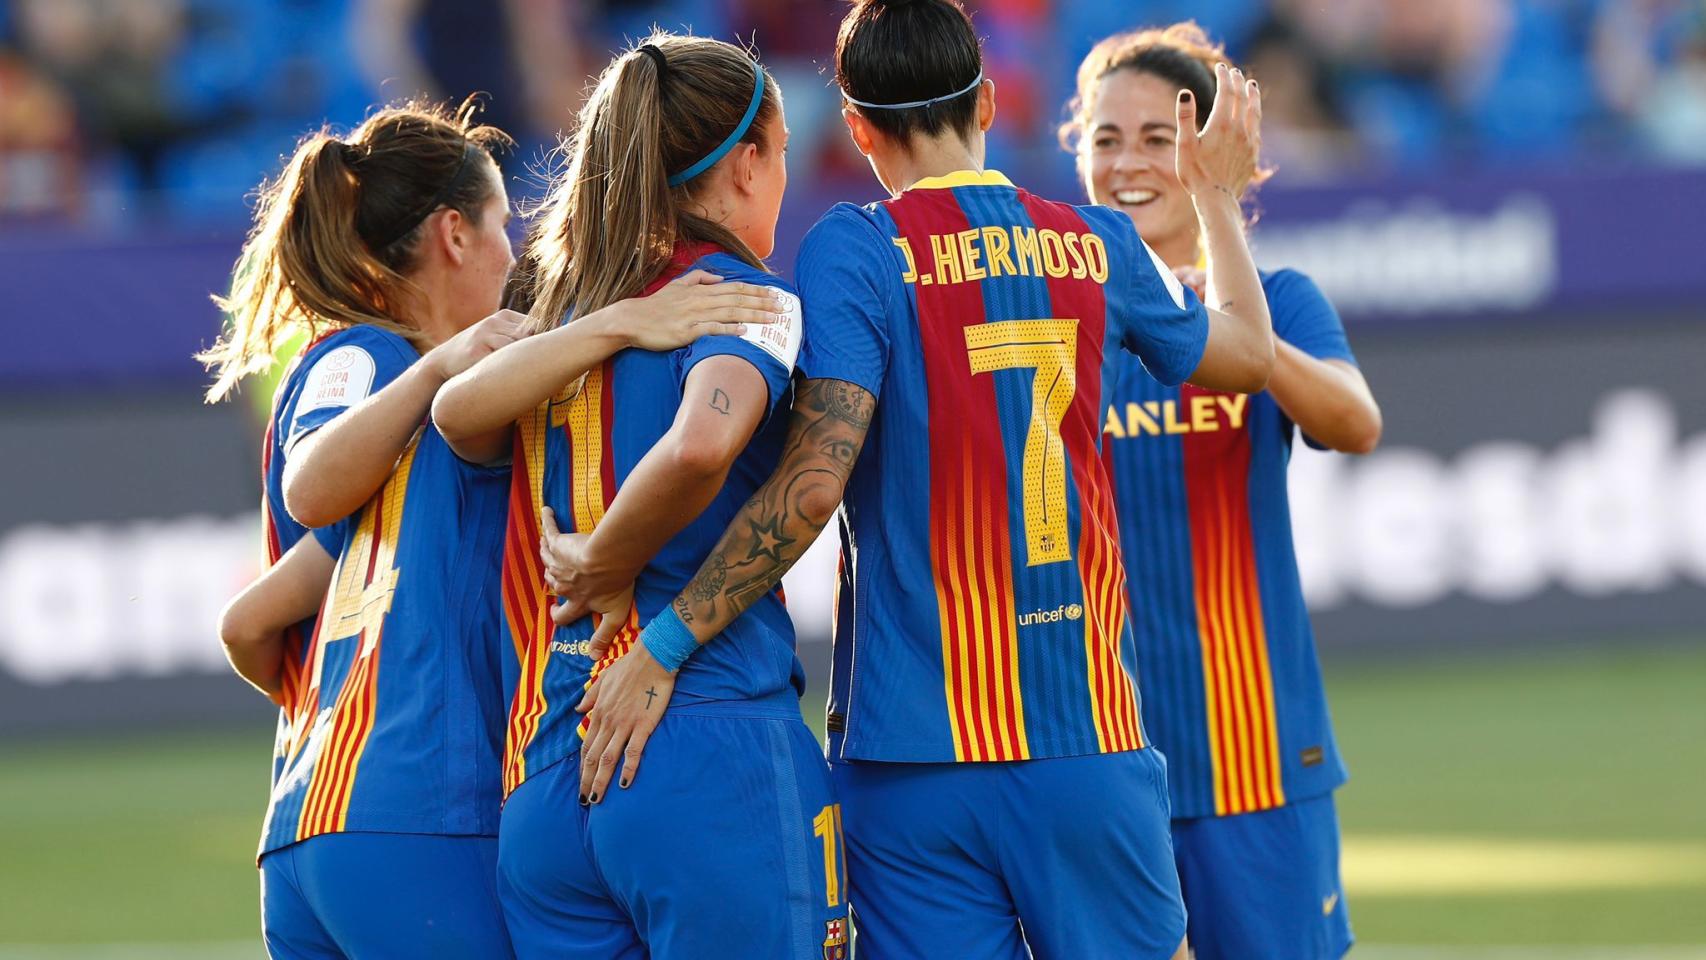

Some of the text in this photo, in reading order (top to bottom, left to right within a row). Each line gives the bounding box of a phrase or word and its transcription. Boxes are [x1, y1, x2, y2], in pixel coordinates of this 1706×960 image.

[891, 226, 1109, 285] J.HERMOSO
[760, 326, 788, 350] REINA
[966, 319, 1080, 566] 7
[1018, 604, 1064, 626] unicef
